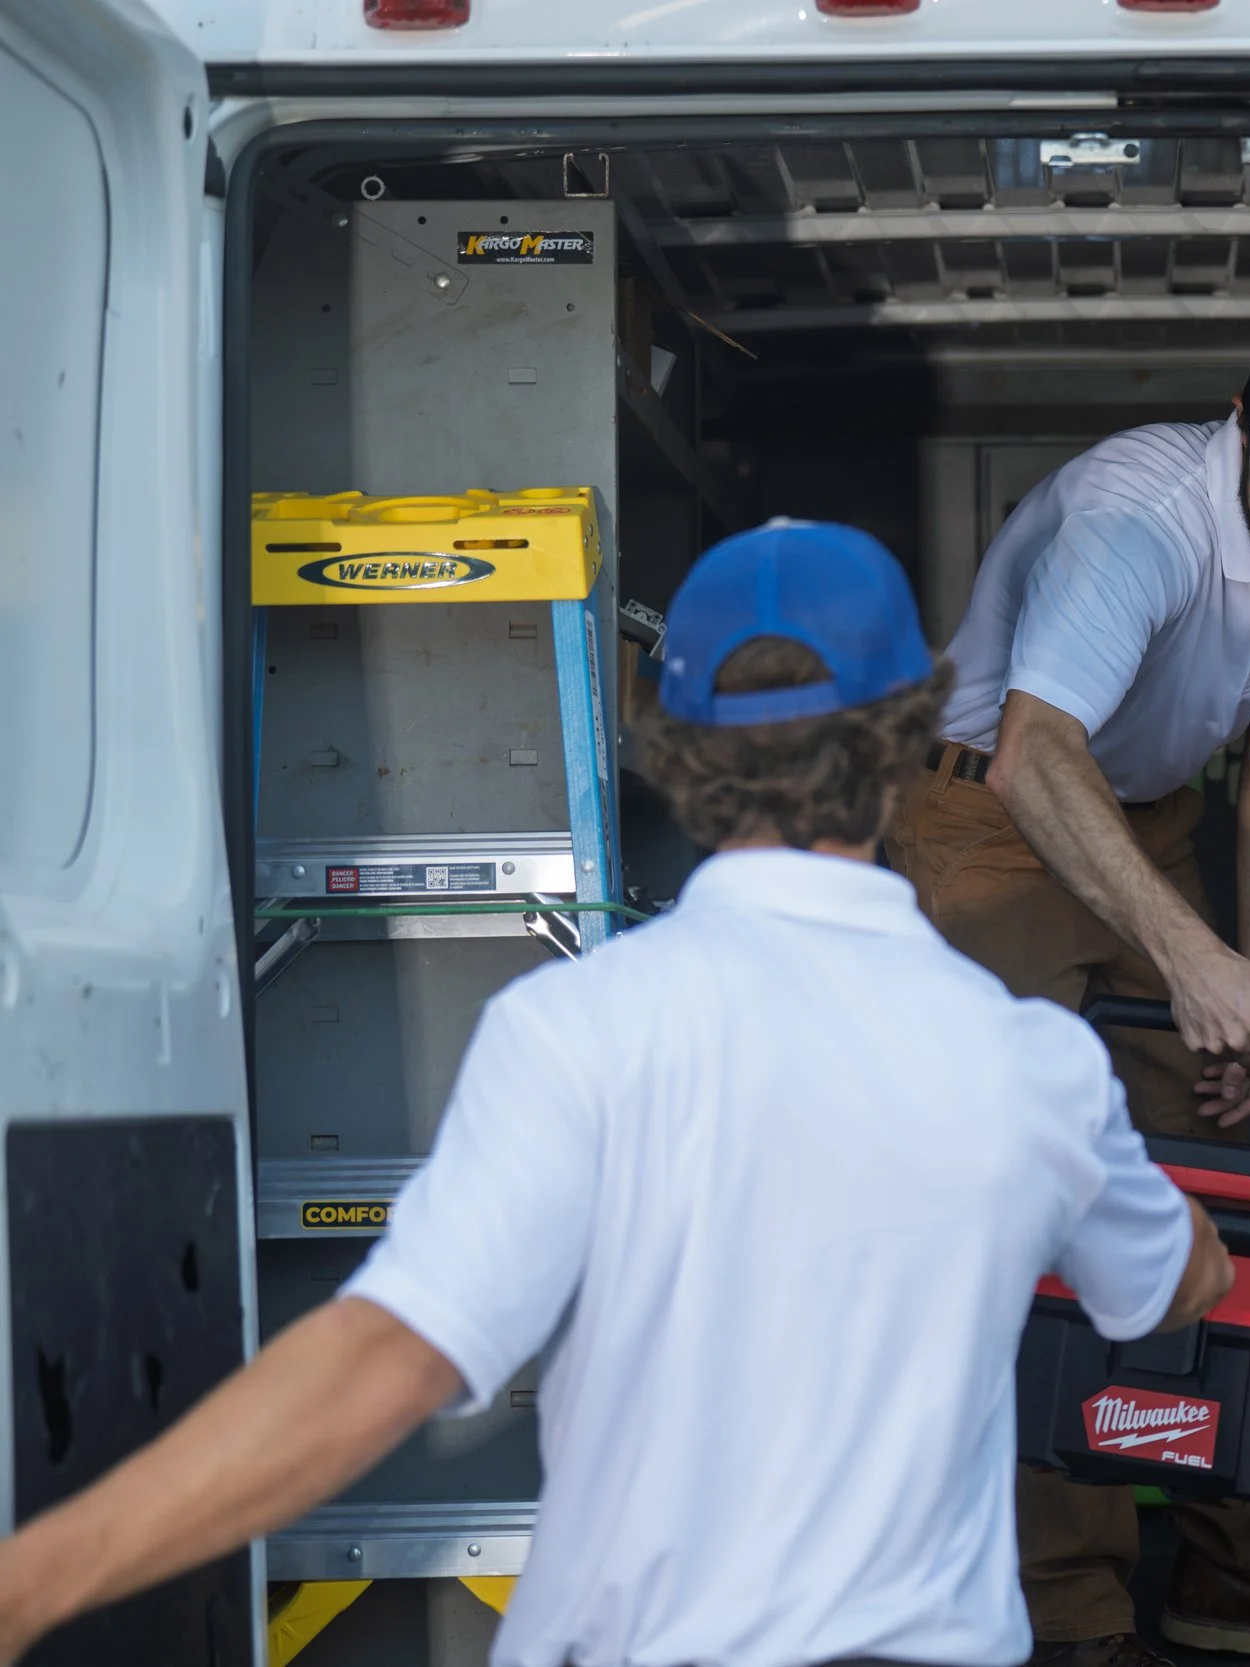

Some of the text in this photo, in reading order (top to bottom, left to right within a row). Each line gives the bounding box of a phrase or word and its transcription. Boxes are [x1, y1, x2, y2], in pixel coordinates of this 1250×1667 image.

[338, 561, 458, 580] WERNER
[1092, 1394, 1210, 1435] Milwaukee
[1161, 1451, 1213, 1469] FUEL
